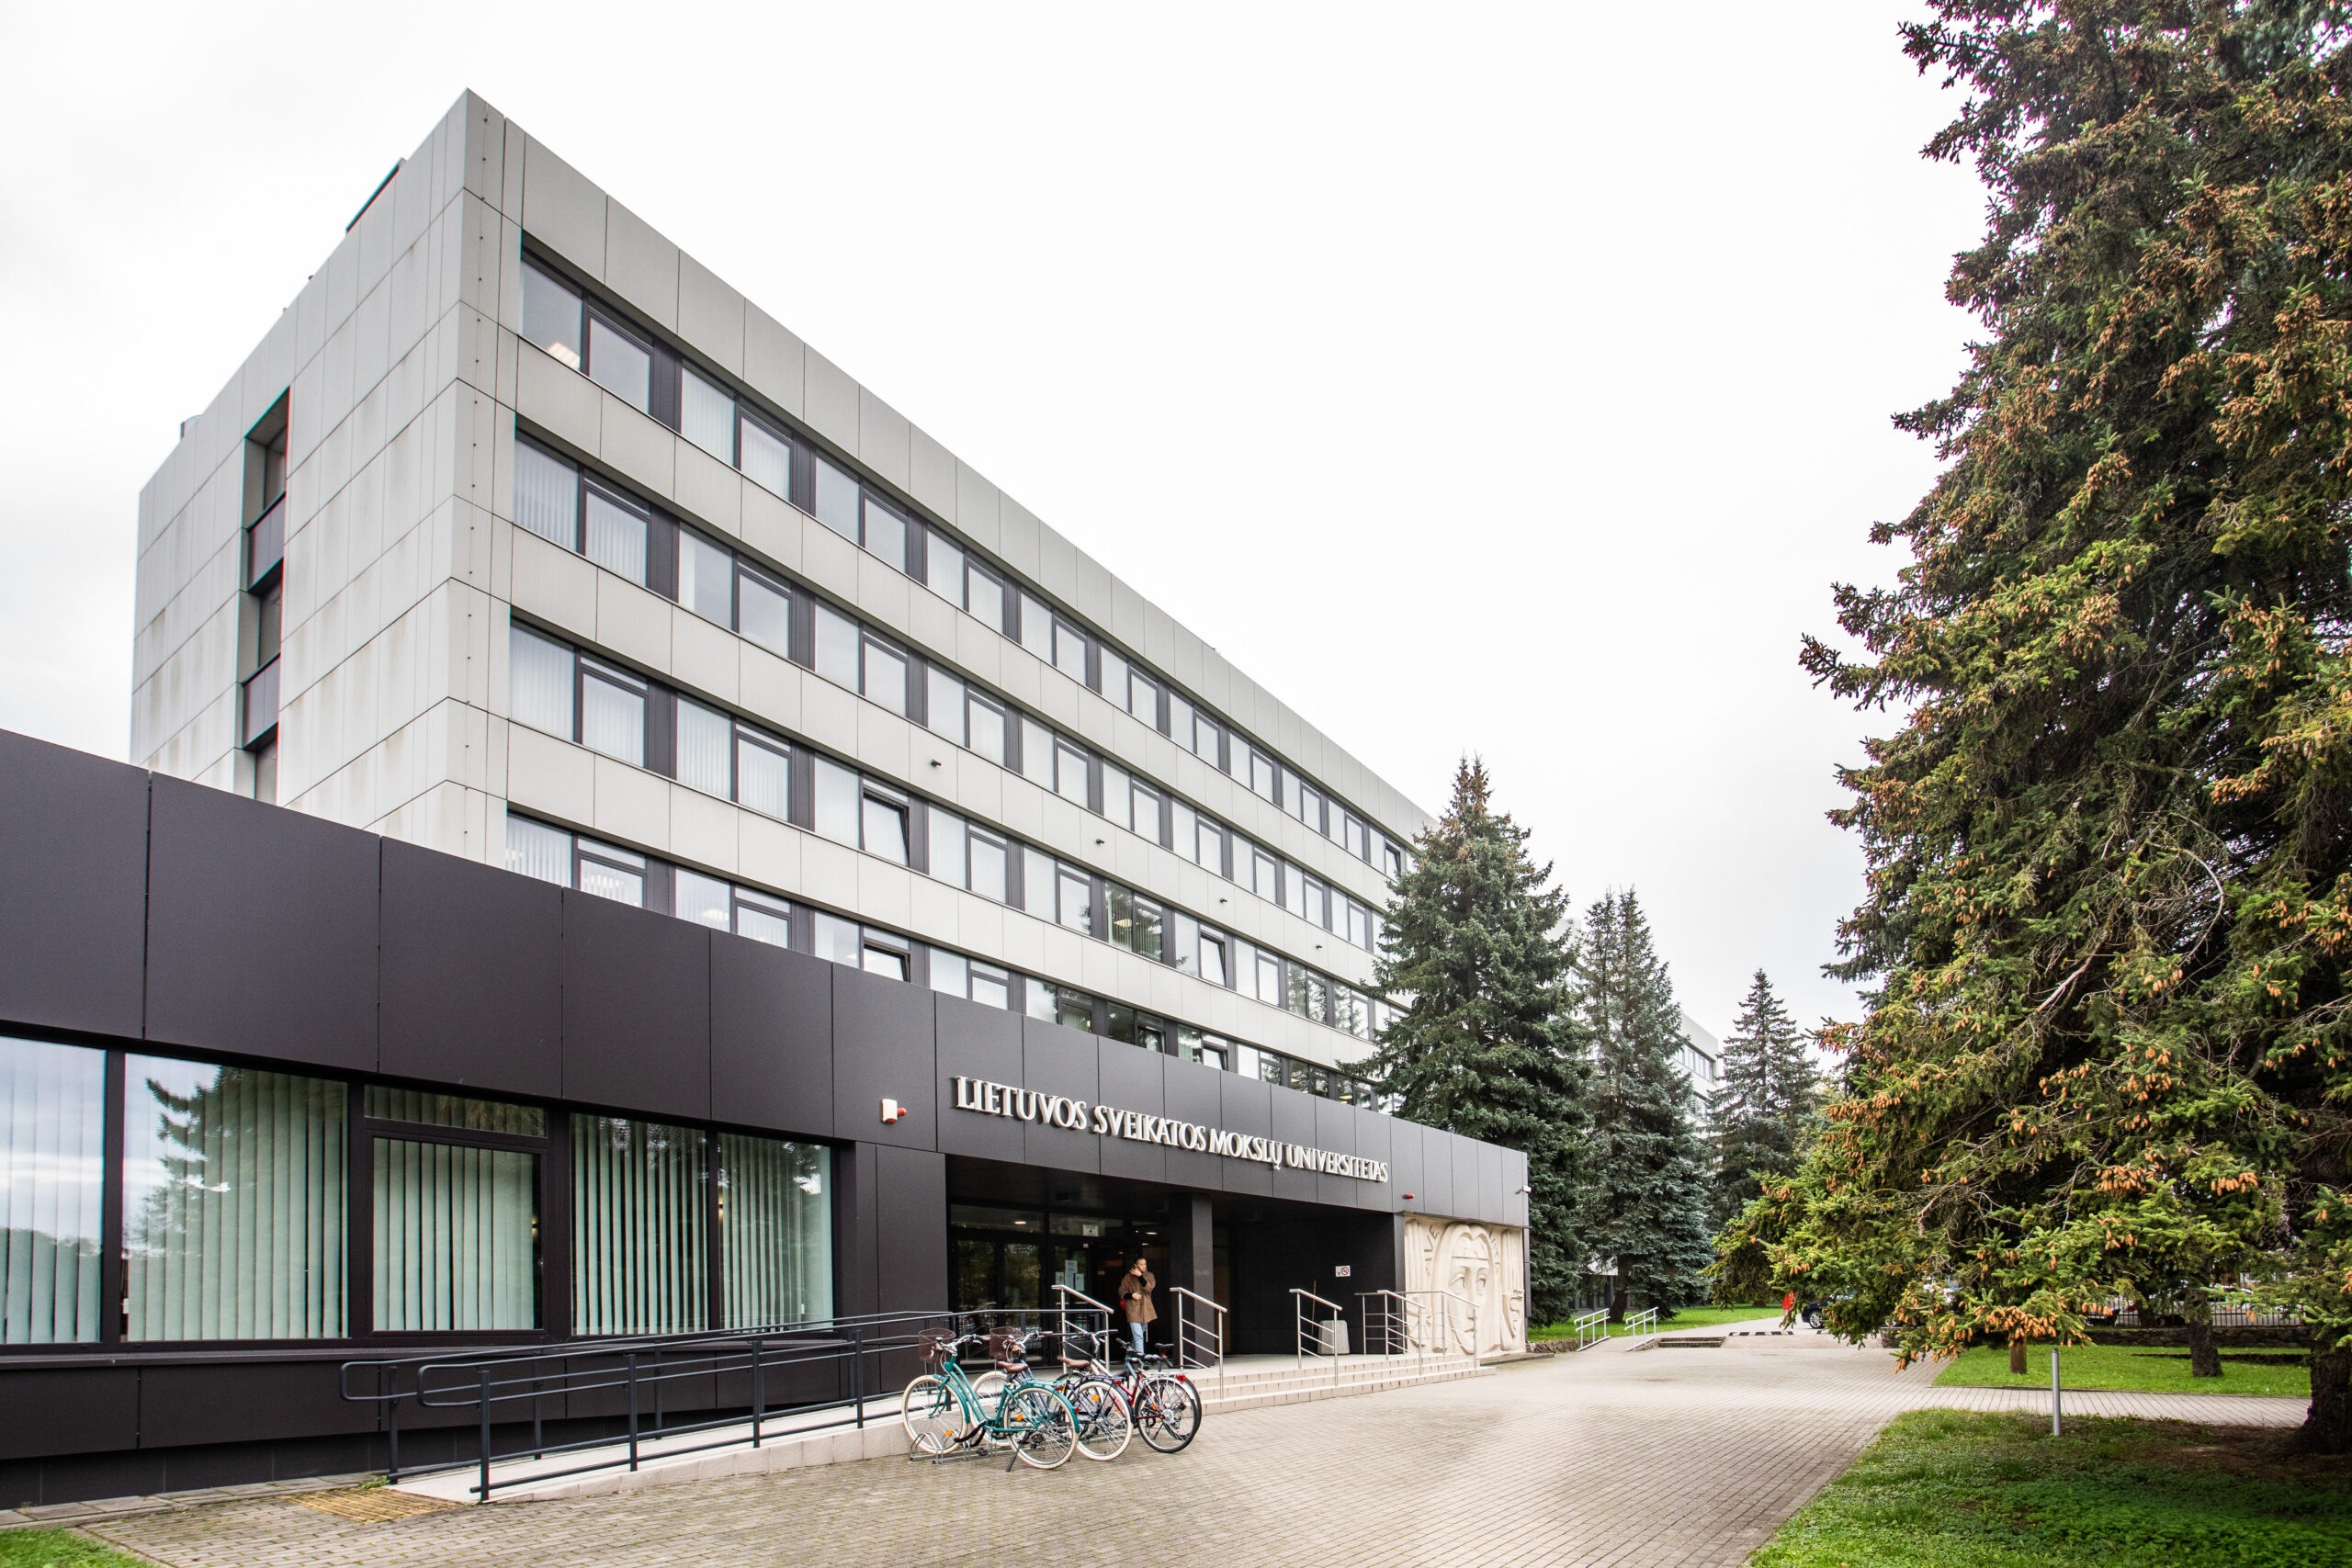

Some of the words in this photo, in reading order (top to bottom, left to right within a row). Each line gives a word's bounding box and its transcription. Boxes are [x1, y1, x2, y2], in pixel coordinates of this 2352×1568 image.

[956, 1075, 1088, 1130] LIETUVOS
[1092, 1105, 1206, 1152] SVEIKATOS
[1208, 1128, 1283, 1171] MOKSLŲ
[1285, 1144, 1389, 1183] UNIVERSITETAS
